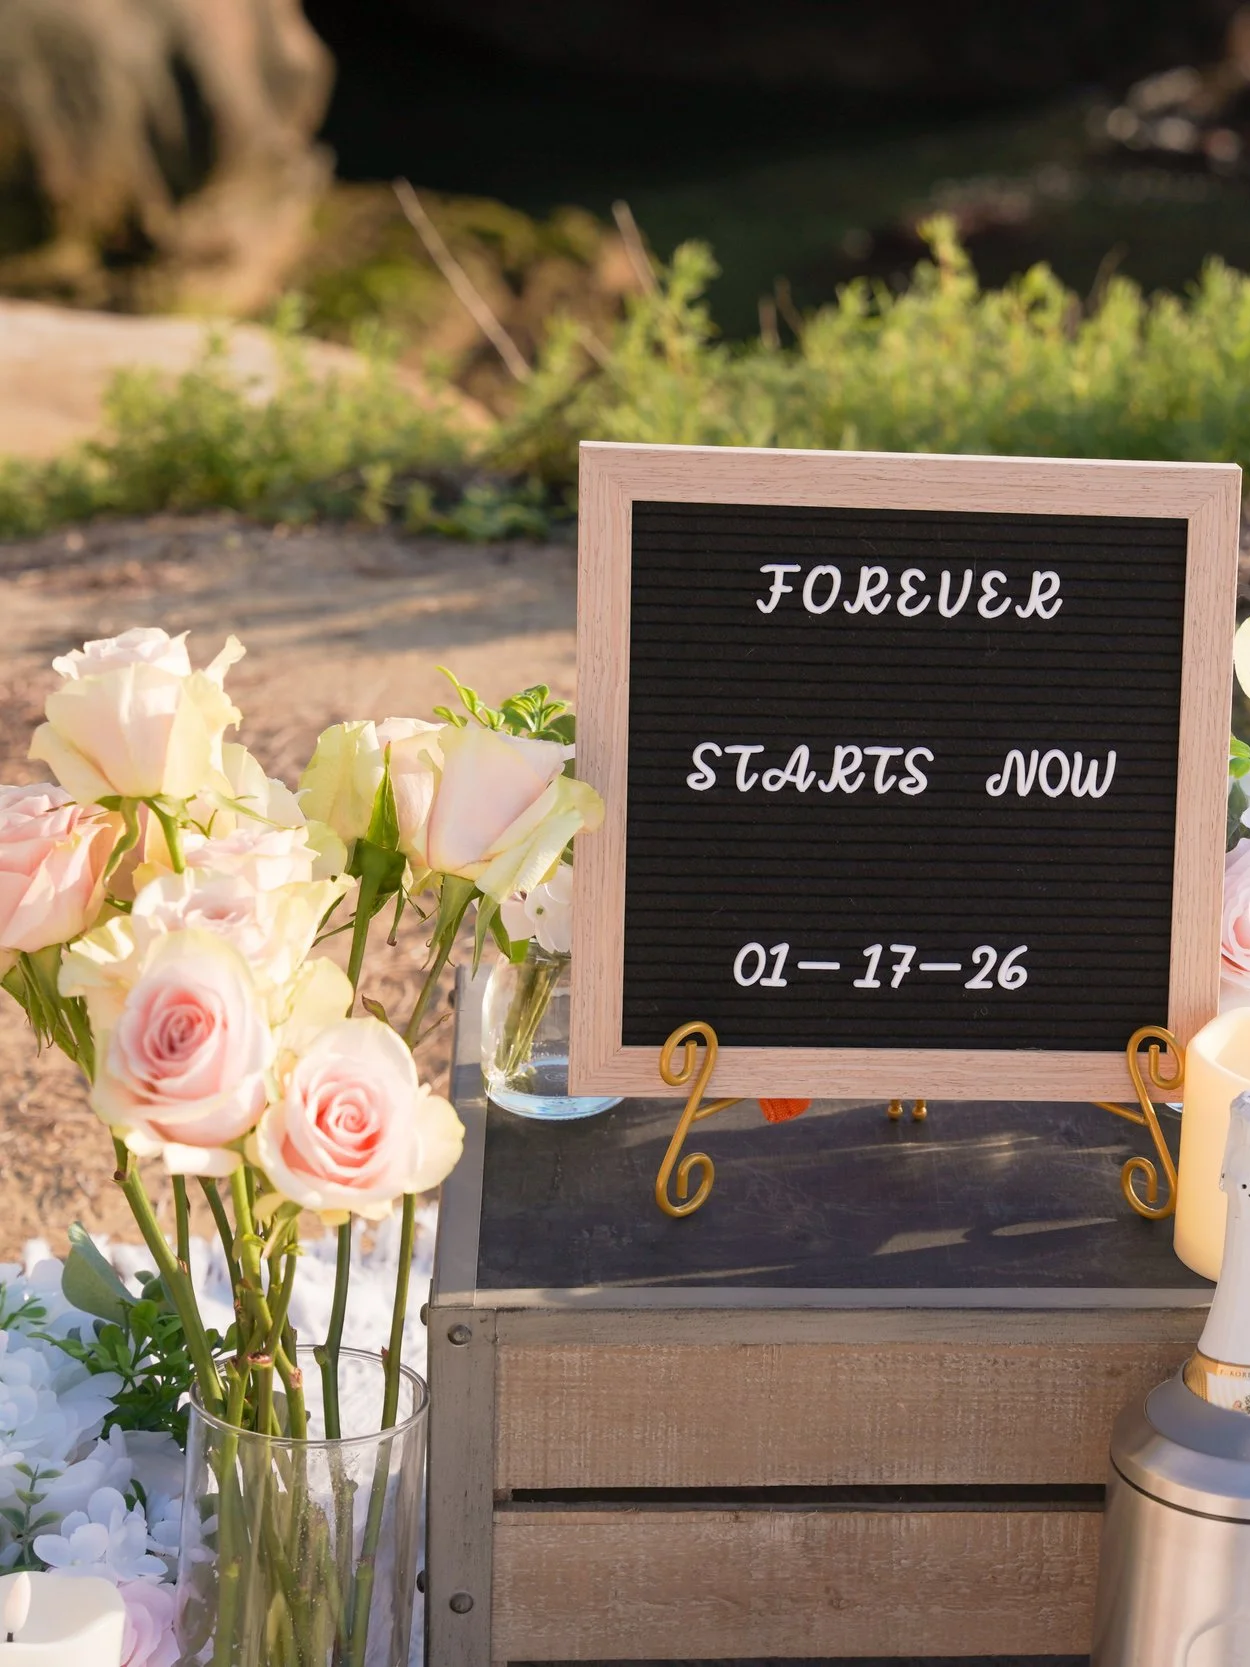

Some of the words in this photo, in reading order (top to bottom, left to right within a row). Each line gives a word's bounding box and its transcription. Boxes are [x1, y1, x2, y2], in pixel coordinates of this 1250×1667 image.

[757, 564, 1063, 620] FOREVER
[686, 742, 935, 796] STARTS
[985, 748, 1117, 799] NOW
